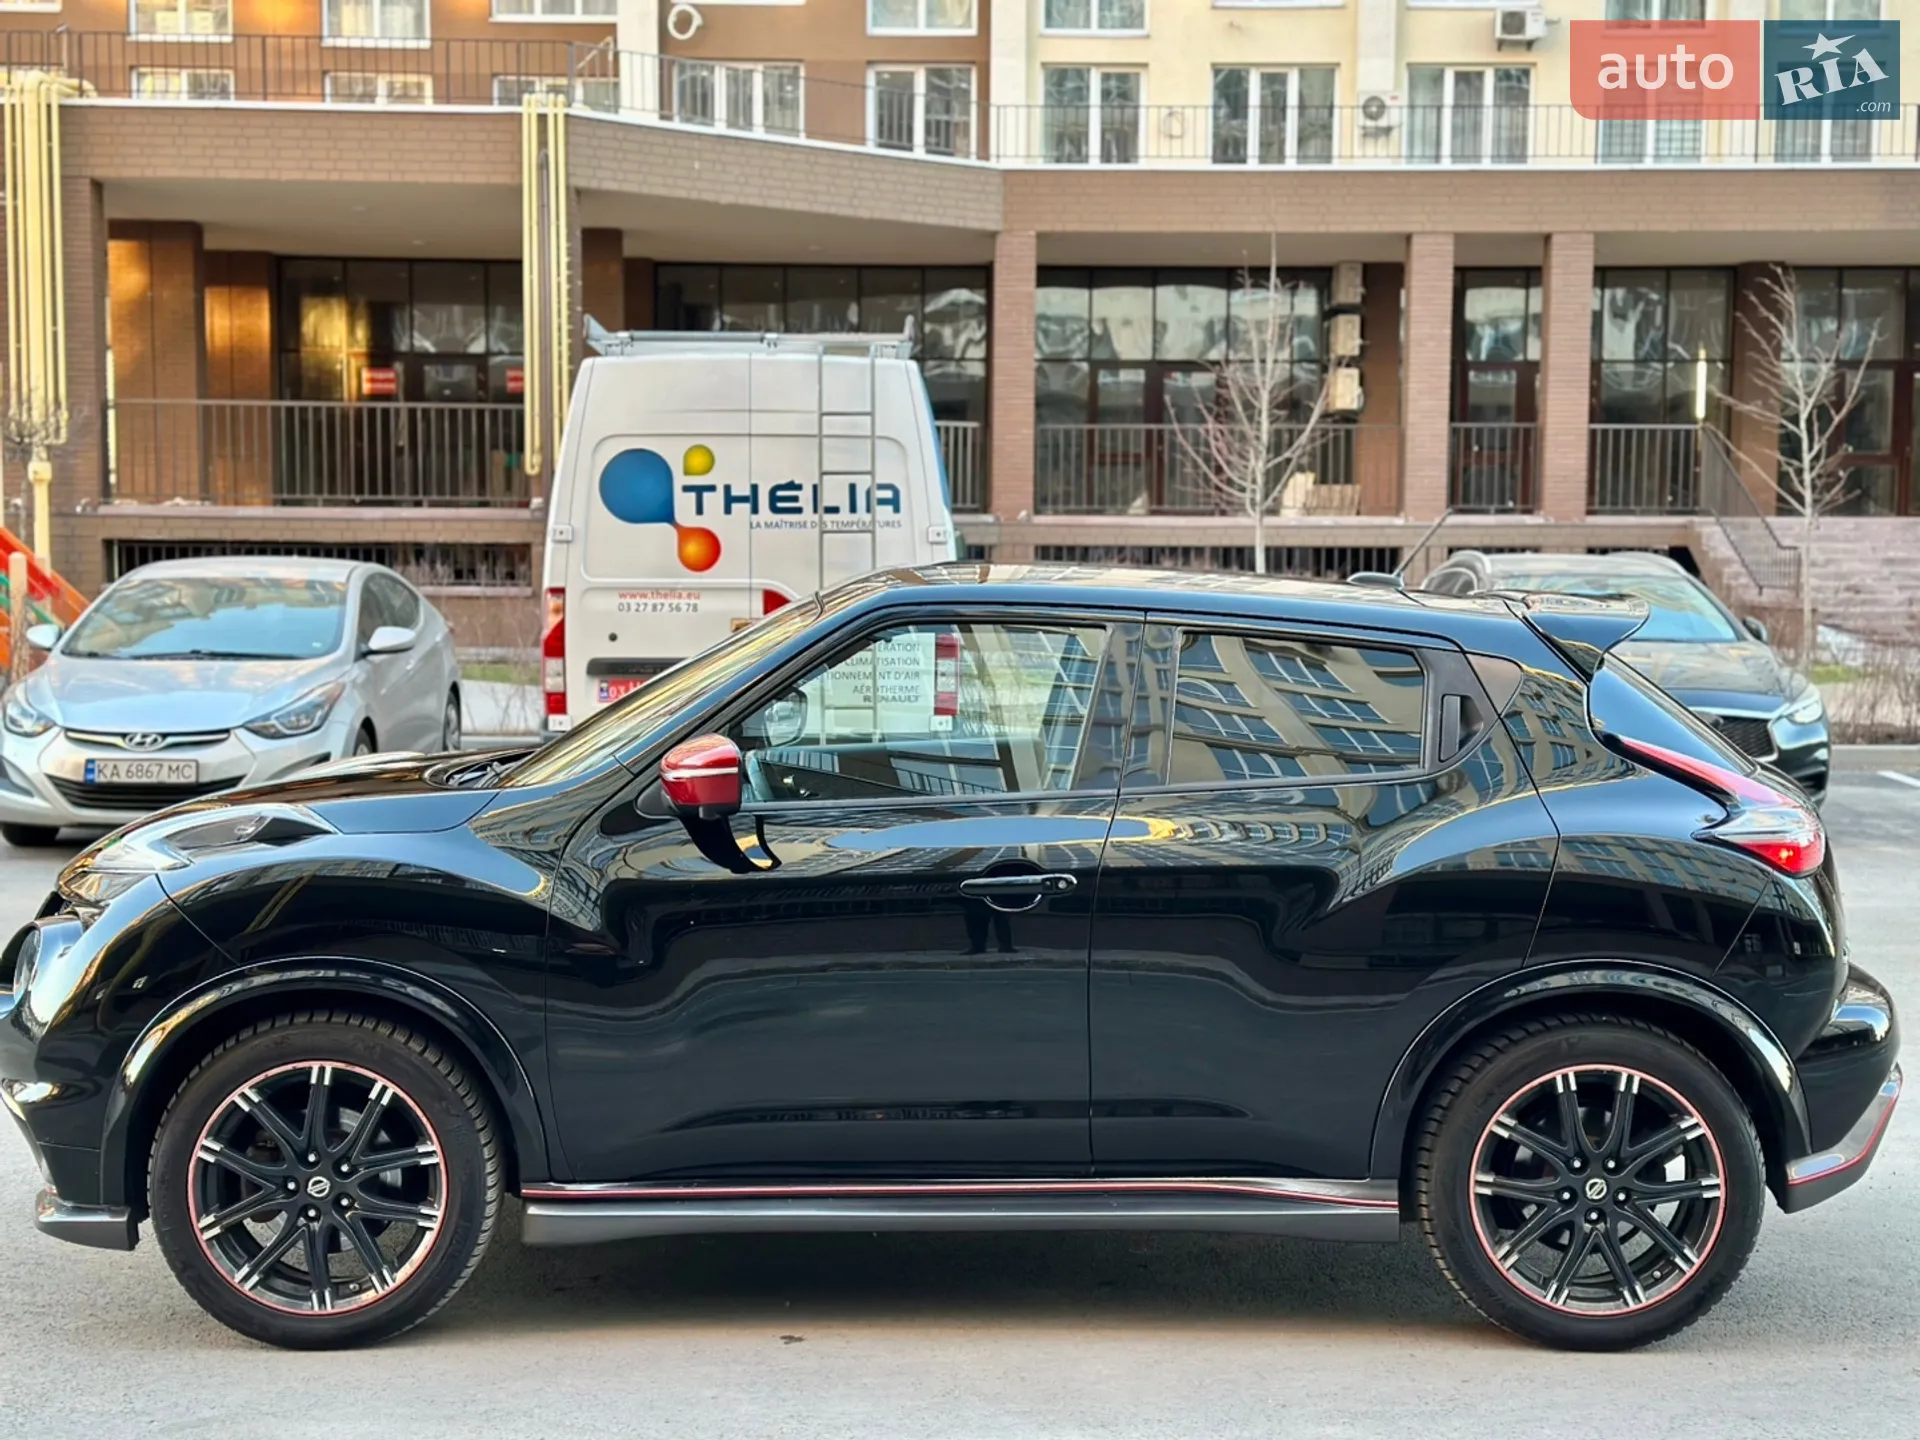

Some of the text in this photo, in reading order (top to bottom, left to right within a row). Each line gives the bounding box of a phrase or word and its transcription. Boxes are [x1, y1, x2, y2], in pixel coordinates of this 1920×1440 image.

[682, 479, 901, 516] THÉLIA
[750, 520, 763, 530] LA
[764, 518, 808, 530] MAÎTRISE
[810, 520, 829, 530] DS
[618, 589, 701, 600] www.thelia.eu
[617, 602, 699, 613] 03 27 87 56 78
[97, 763, 121, 780] KA
[125, 763, 164, 780] 6867
[167, 763, 193, 780] MC
